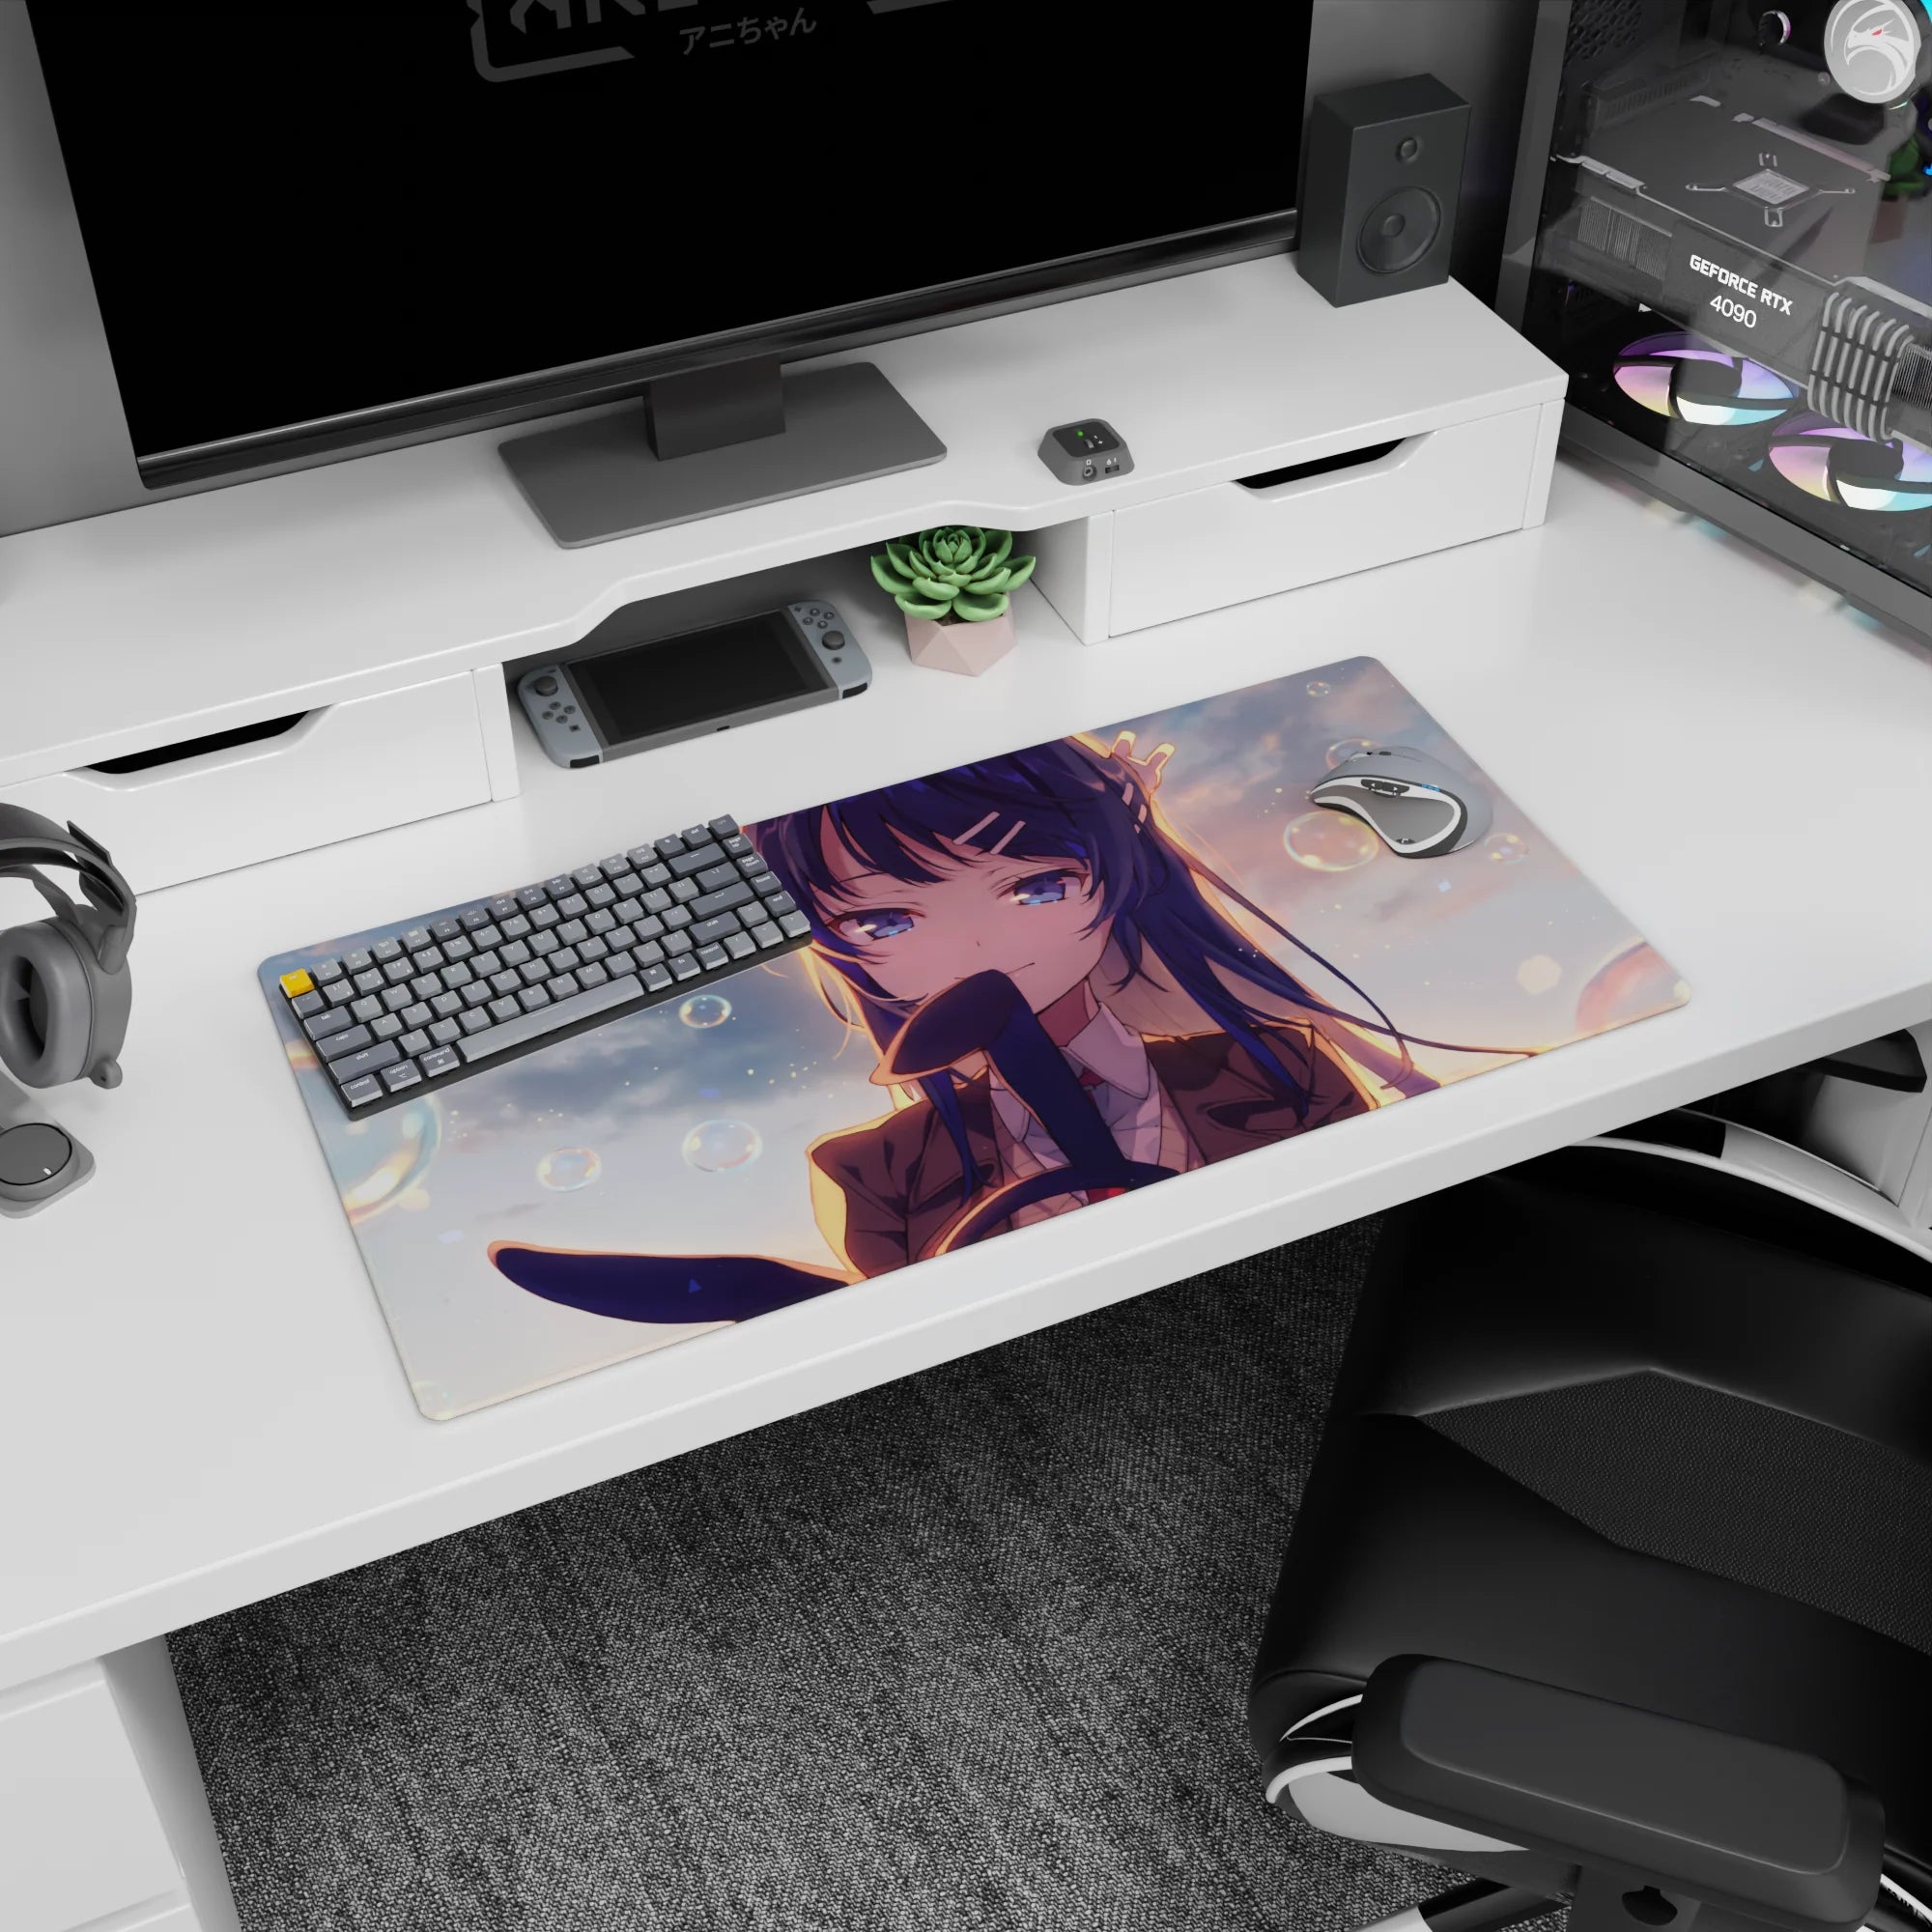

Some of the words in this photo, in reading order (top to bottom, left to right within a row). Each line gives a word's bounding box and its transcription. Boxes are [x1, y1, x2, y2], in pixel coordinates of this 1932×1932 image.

[679, 6, 817, 56] アニちゃん
[1690, 254, 1759, 298] GEFORCE
[1760, 288, 1794, 316] RTX
[1709, 295, 1757, 328] 4090
[745, 859, 760, 867] down
[423, 1047, 450, 1061] command
[389, 1065, 409, 1074] option
[350, 1078, 370, 1090] control
